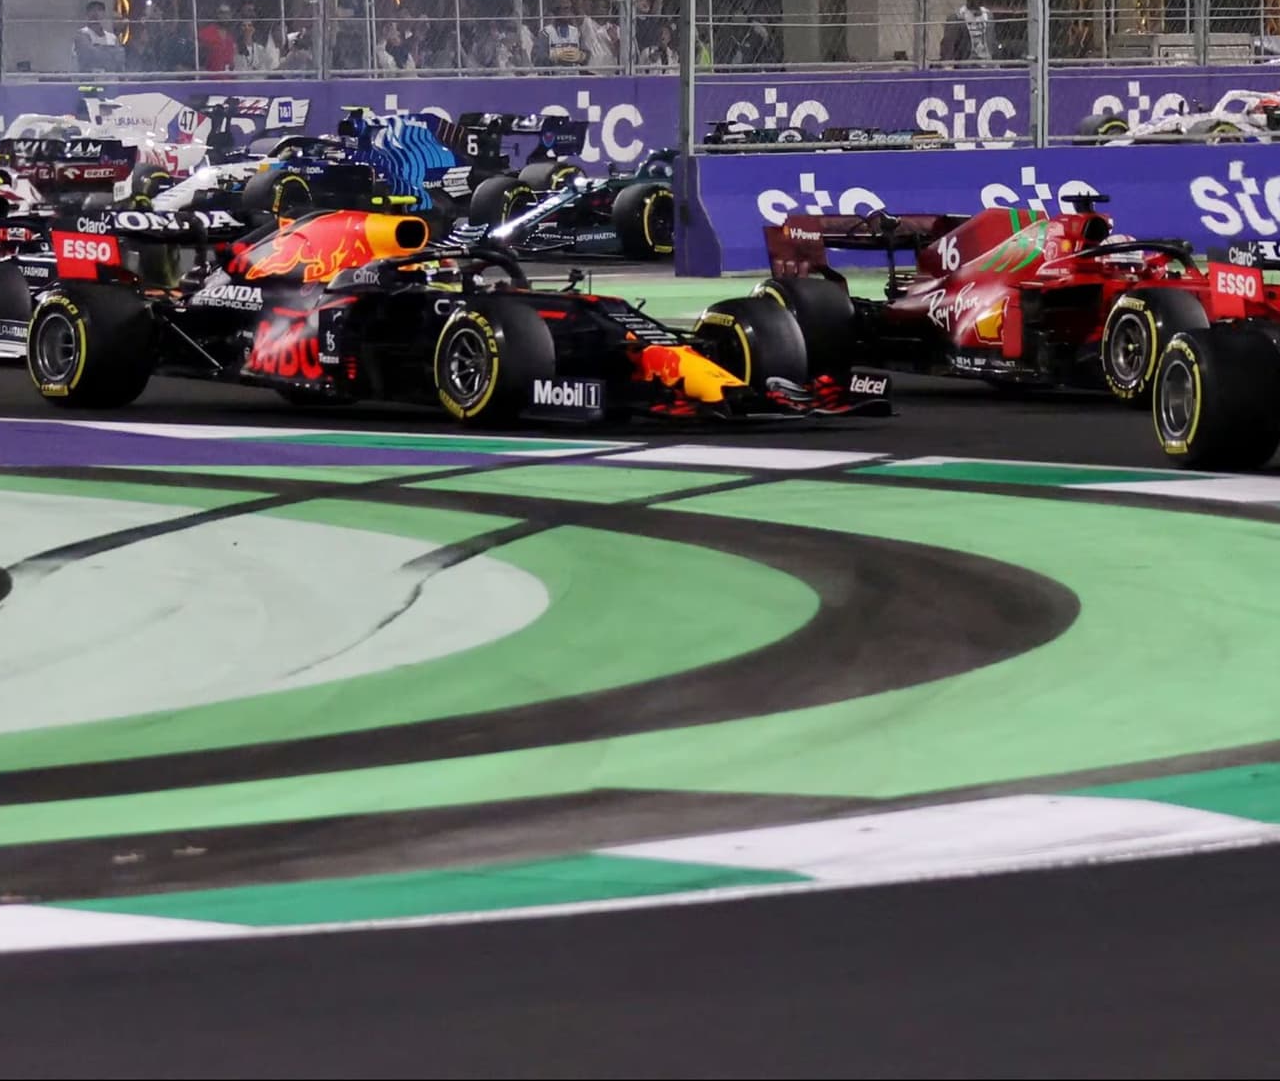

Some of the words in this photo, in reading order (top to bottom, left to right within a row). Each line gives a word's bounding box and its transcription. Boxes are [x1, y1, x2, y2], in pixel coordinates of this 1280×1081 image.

[180, 110, 195, 131] 47
[540, 91, 644, 162] tc
[916, 85, 1016, 149] stc
[467, 134, 479, 156] 6
[77, 217, 106, 234] Claro
[790, 227, 821, 240] V-Power
[63, 239, 111, 262] ESSO
[937, 236, 960, 271] 16
[1228, 247, 1253, 267] Claro
[198, 283, 264, 303] HONDA
[1217, 271, 1257, 298] ESSO
[534, 380, 584, 406] Mobil
[850, 373, 887, 395] telcel
